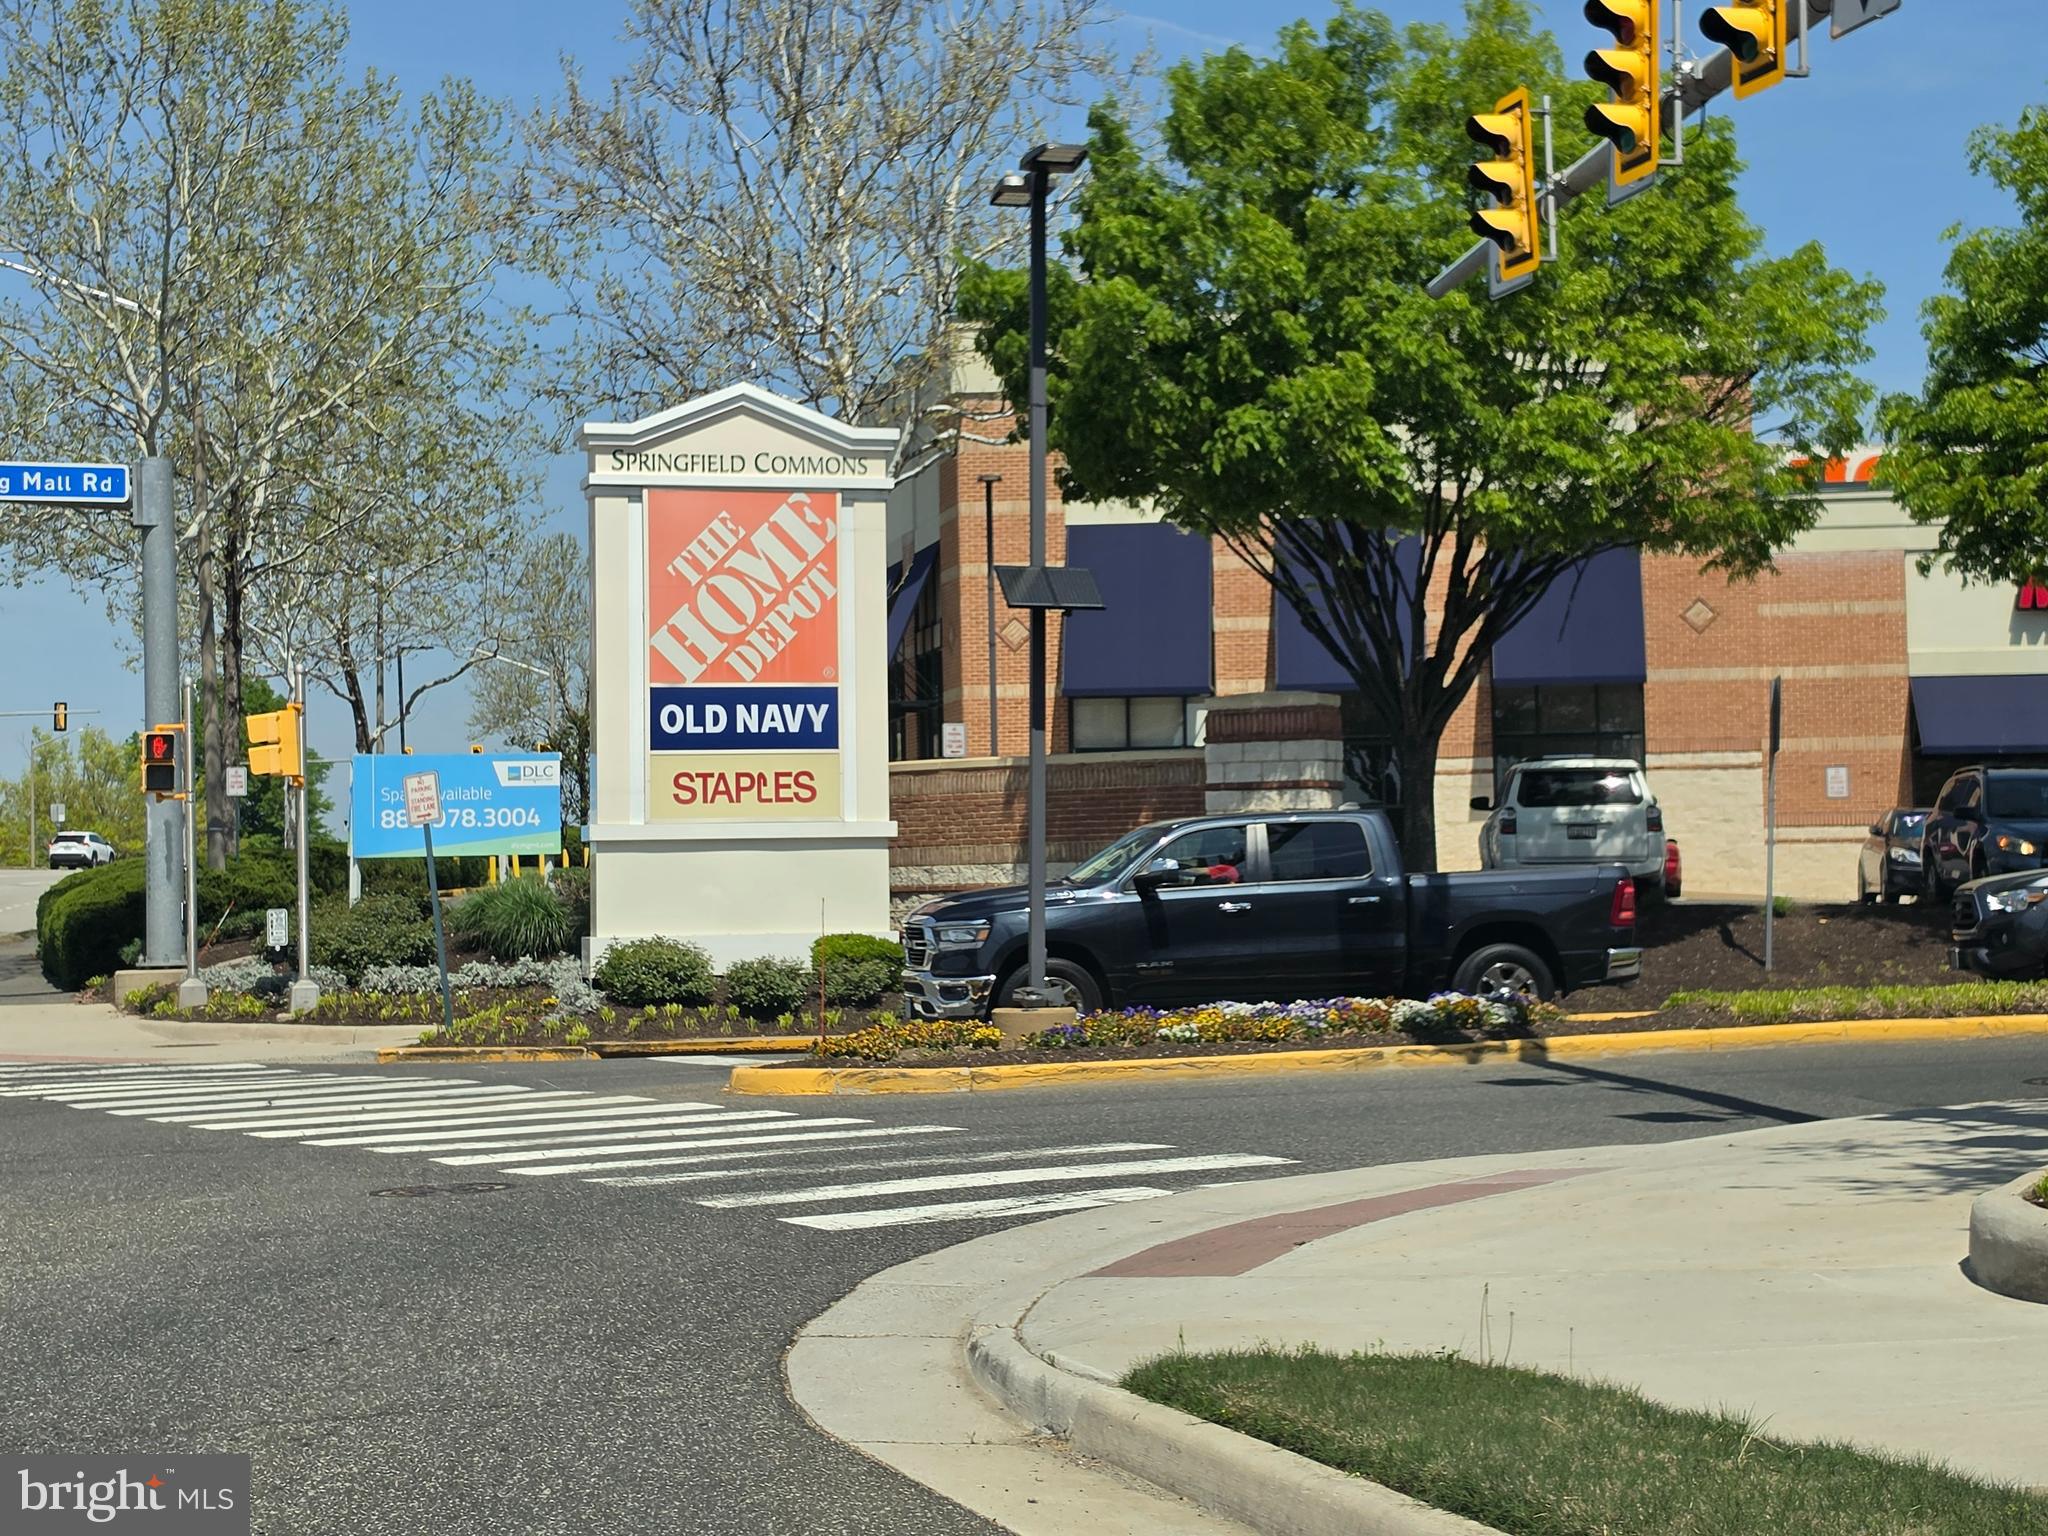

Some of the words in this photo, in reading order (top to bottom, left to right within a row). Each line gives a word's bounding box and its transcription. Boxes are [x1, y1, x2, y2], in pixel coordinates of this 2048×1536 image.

[611, 449, 746, 474] SPRINGFIELD
[754, 452, 869, 476] COMMONS
[23, 471, 72, 492] Mall
[83, 472, 112, 493] Rd
[666, 510, 747, 587] THE
[650, 492, 837, 684] HOME
[723, 561, 837, 682] DEPOT
[659, 704, 728, 734] OLD
[736, 703, 830, 733] NAVY
[522, 765, 554, 778] DLC
[672, 770, 818, 805] STAPLES
